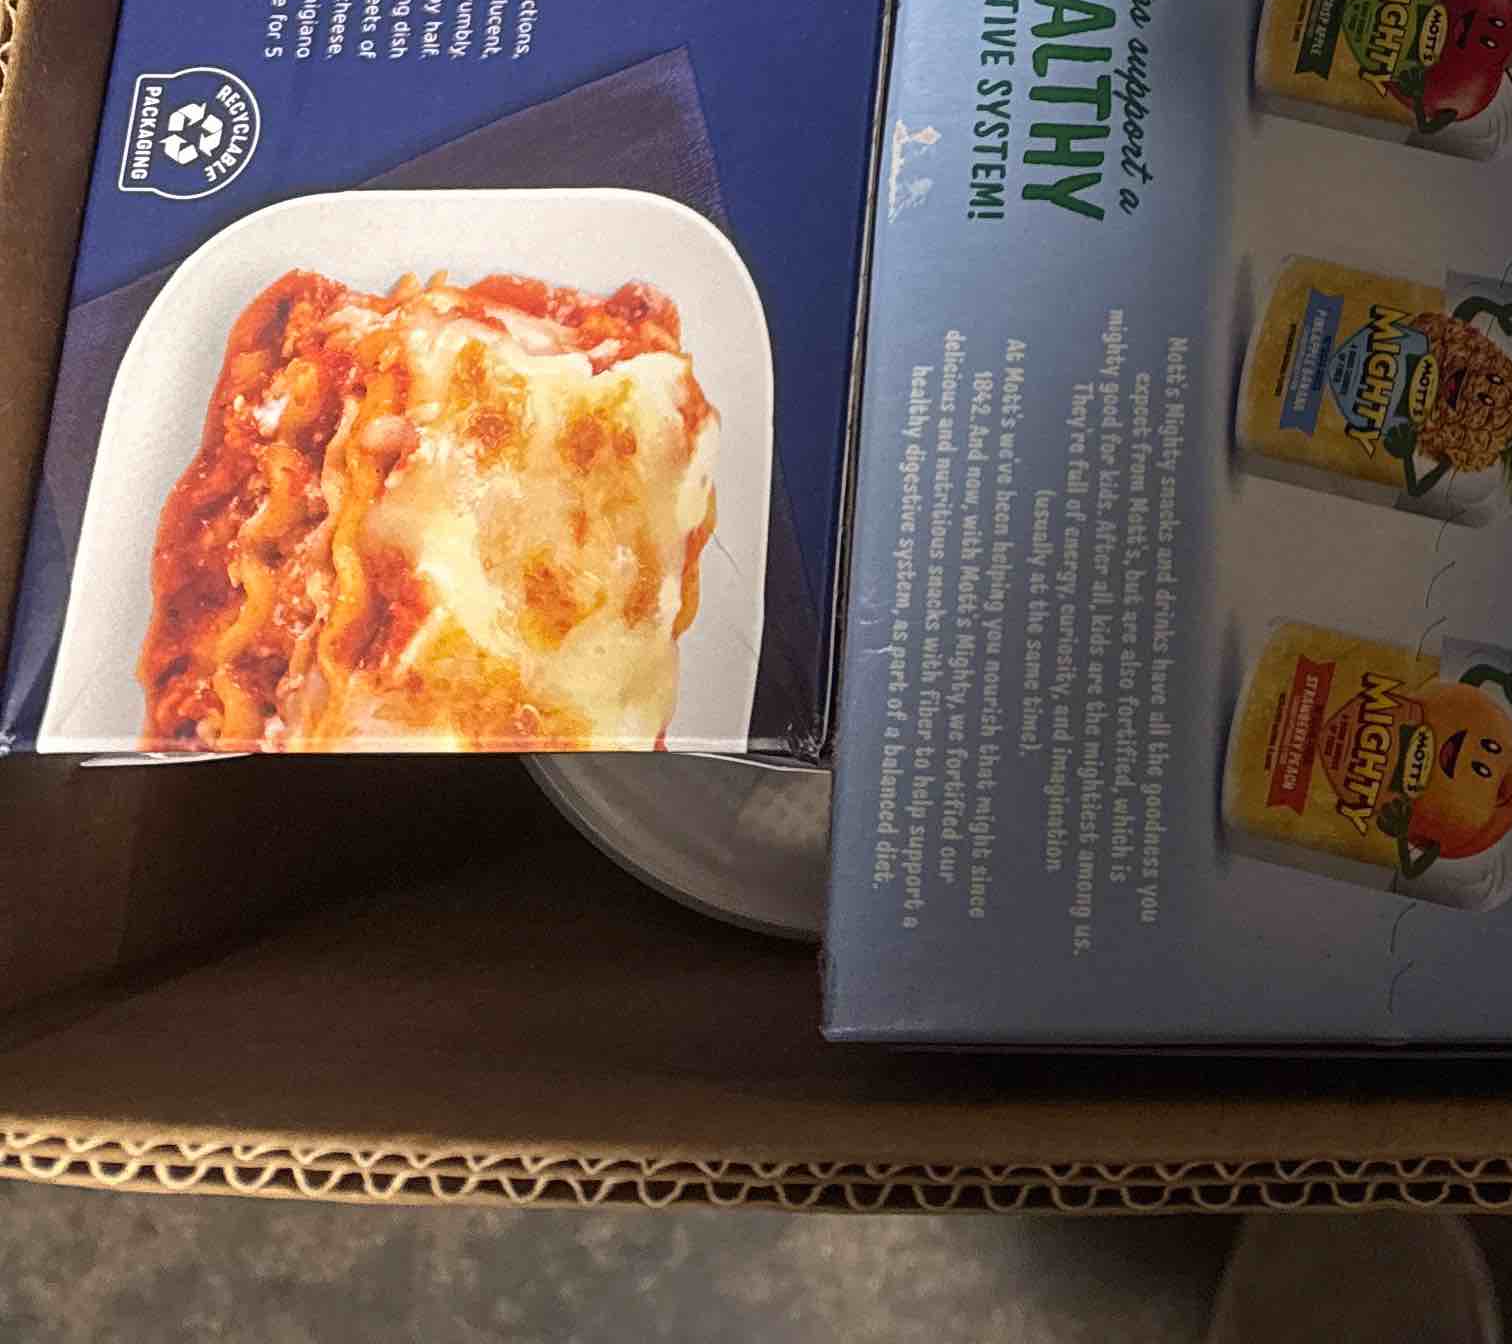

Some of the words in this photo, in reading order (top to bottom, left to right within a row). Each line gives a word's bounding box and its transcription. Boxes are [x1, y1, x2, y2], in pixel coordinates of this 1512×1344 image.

[131, 85, 163, 180] PACKAGING
[203, 84, 250, 183] RECYCLABLE
[968, 78, 1013, 220] SYSTEM!
[1113, 38, 1153, 184] support
[1118, 188, 1140, 217] a
